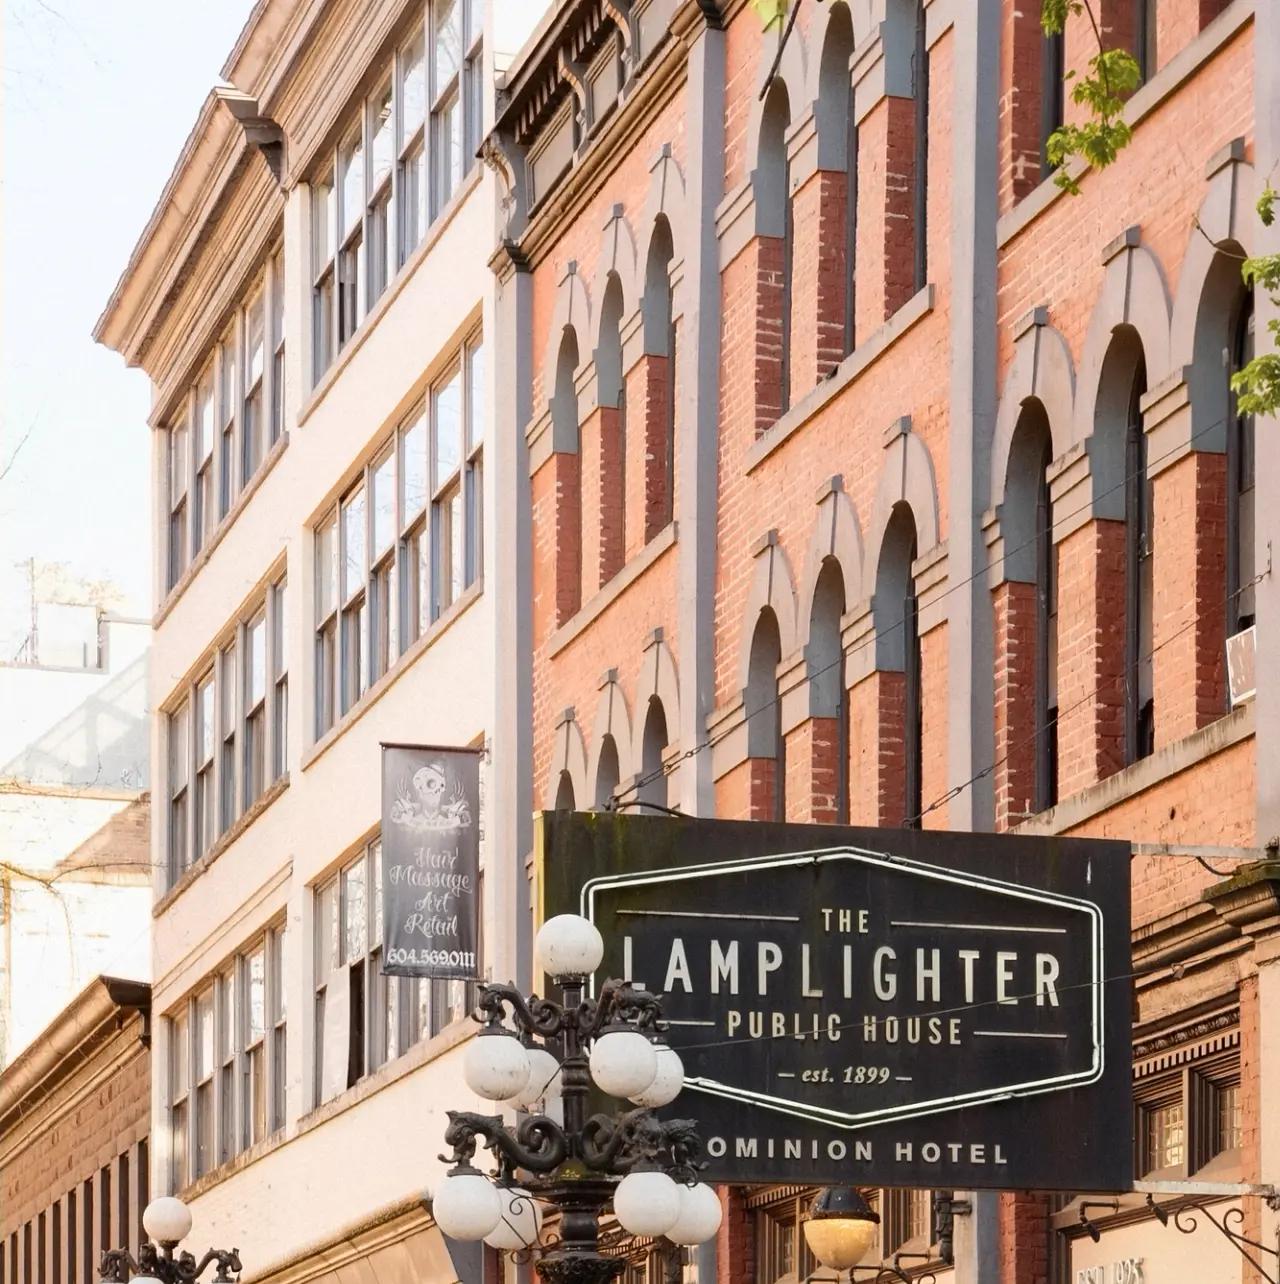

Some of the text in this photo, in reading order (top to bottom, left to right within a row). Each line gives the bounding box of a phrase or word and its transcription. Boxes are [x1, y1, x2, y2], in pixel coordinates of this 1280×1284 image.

[414, 847, 459, 869] Hair
[389, 865, 473, 898] Massage
[415, 891, 453, 913] Art
[404, 914, 458, 939] Retail
[821, 907, 871, 934] THE
[622, 935, 1061, 1008] LAMPLIGHTER
[727, 1009, 963, 1046] PUBLIC HOUSE
[801, 1066, 891, 1085] est. 1899
[671, 1135, 1009, 1165] OMINION HOTEL
